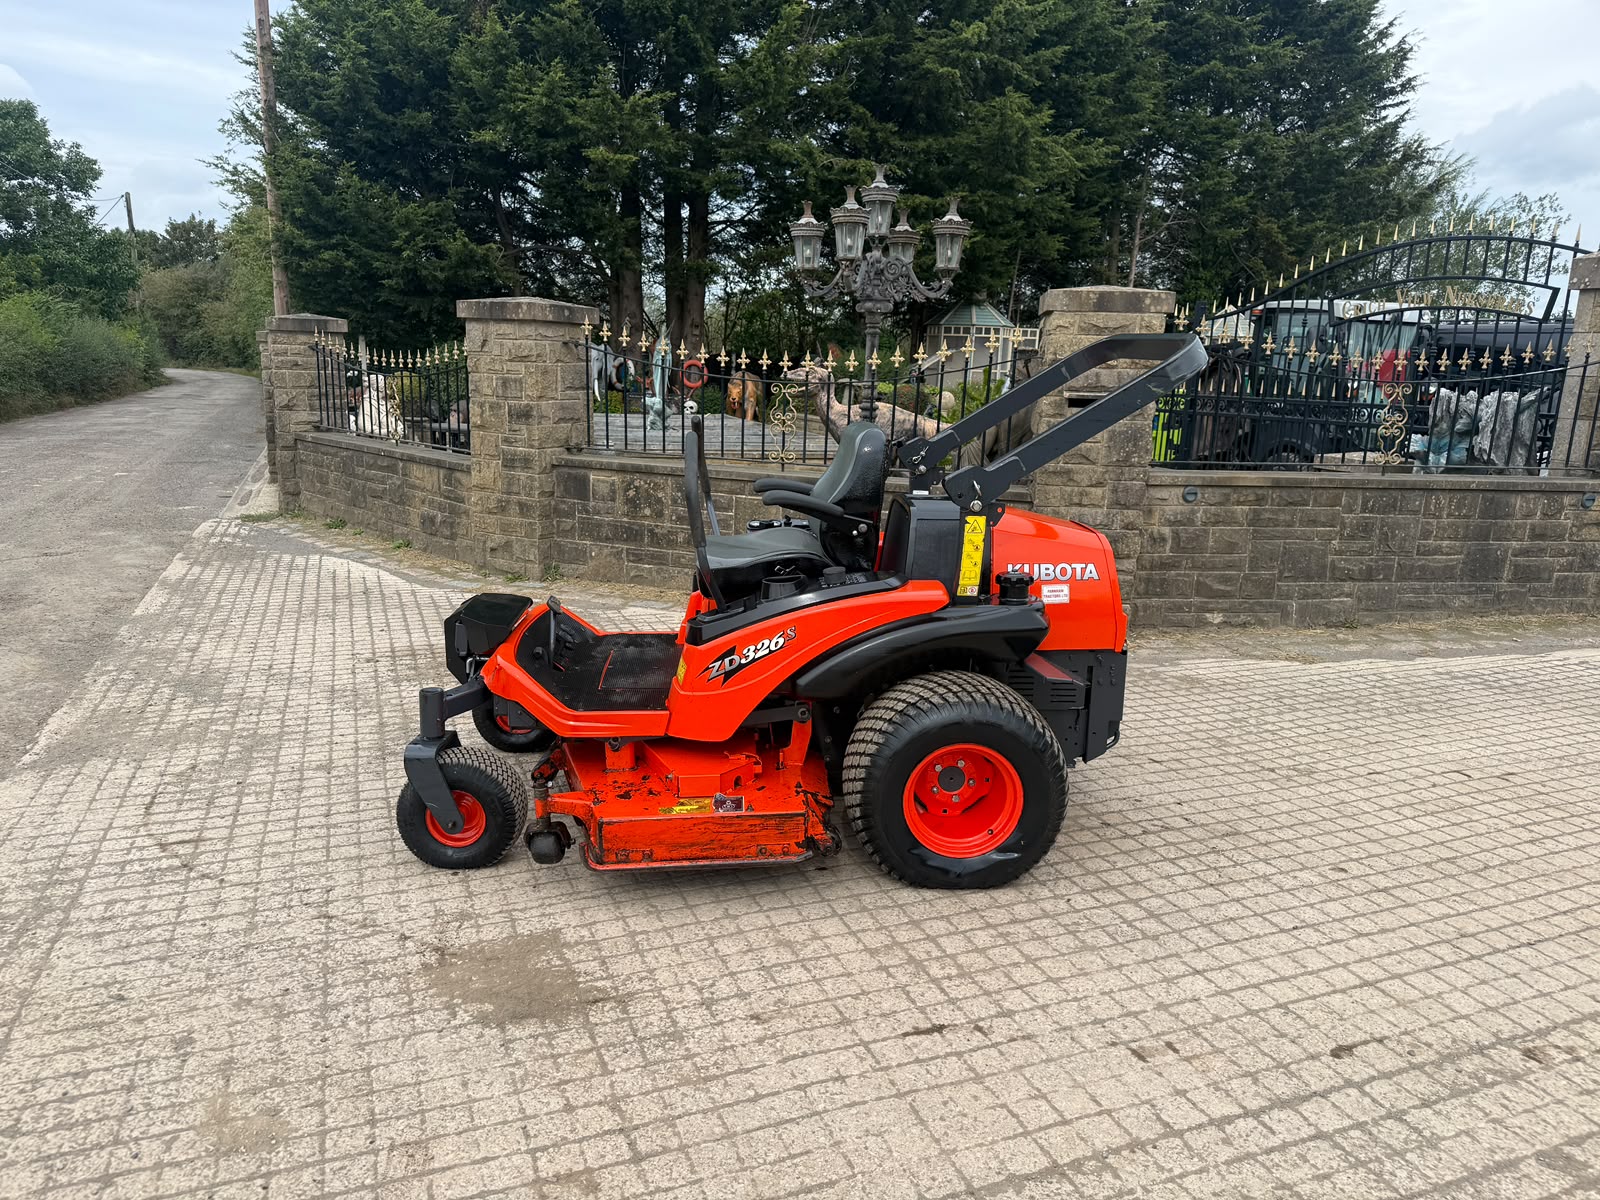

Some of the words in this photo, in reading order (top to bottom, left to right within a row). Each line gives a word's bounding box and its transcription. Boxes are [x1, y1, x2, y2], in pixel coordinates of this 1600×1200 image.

[1342, 299, 1386, 320] CRICH
[1396, 288, 1433, 308] VIEW
[1442, 285, 1536, 316] NURSERIES
